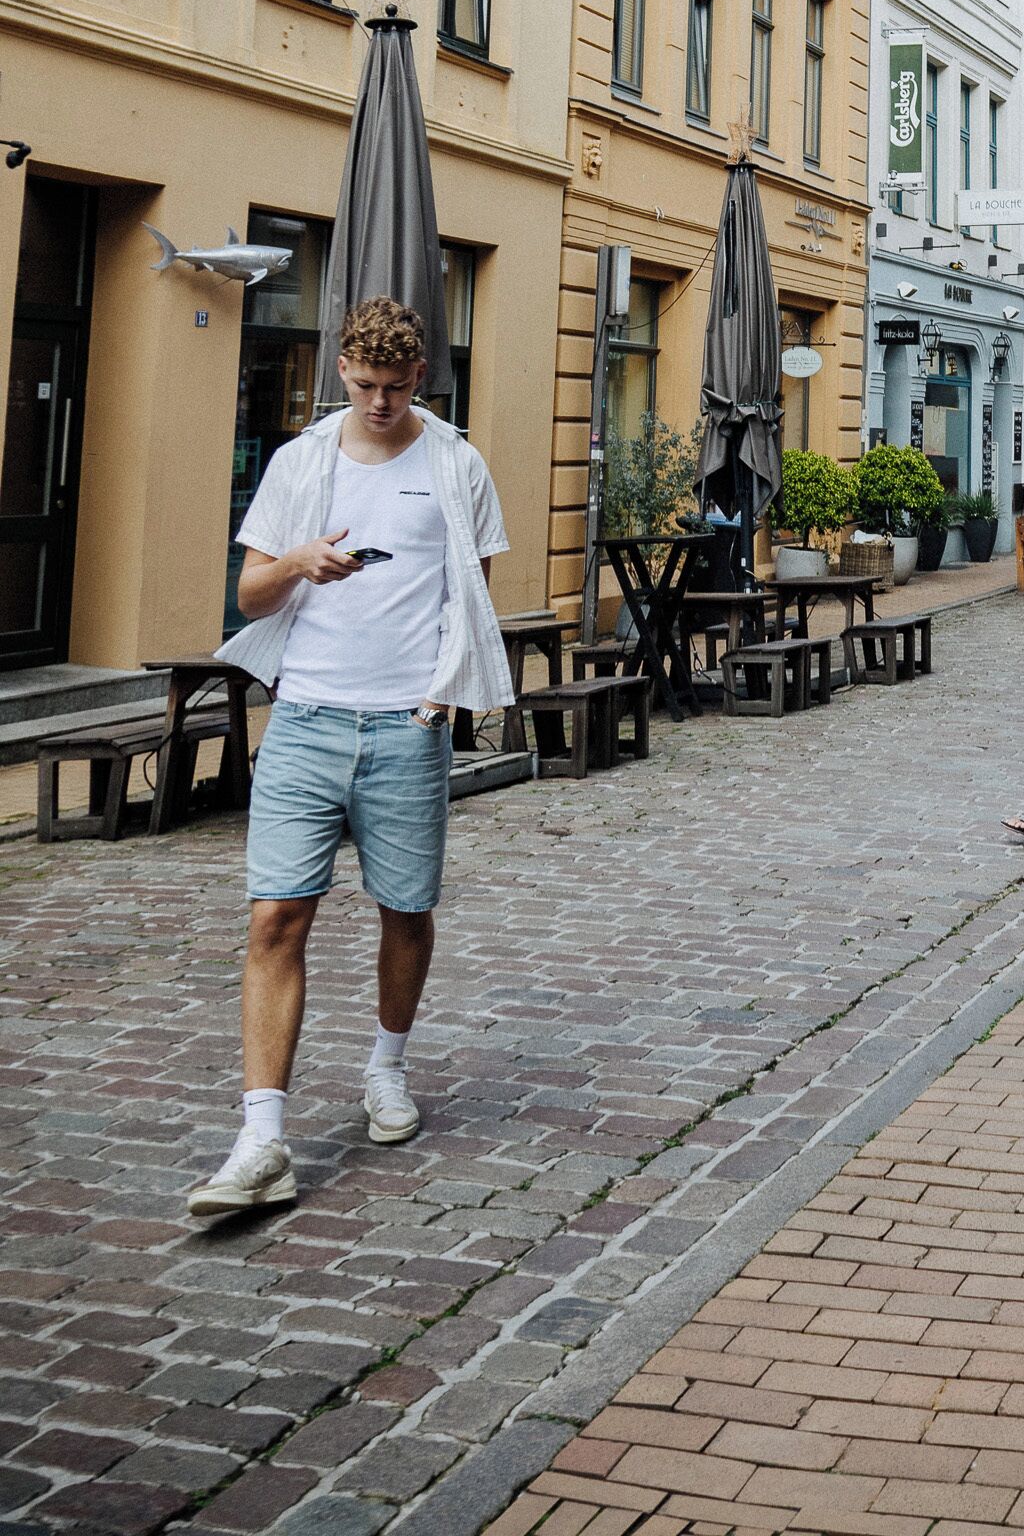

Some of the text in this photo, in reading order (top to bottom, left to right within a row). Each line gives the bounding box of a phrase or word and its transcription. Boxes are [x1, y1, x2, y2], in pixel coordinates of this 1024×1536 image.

[890, 71, 920, 147] Carlsberg
[970, 199, 1024, 210] LA BOUCHE
[199, 312, 206, 325] 13
[883, 328, 914, 338] fritz-kola
